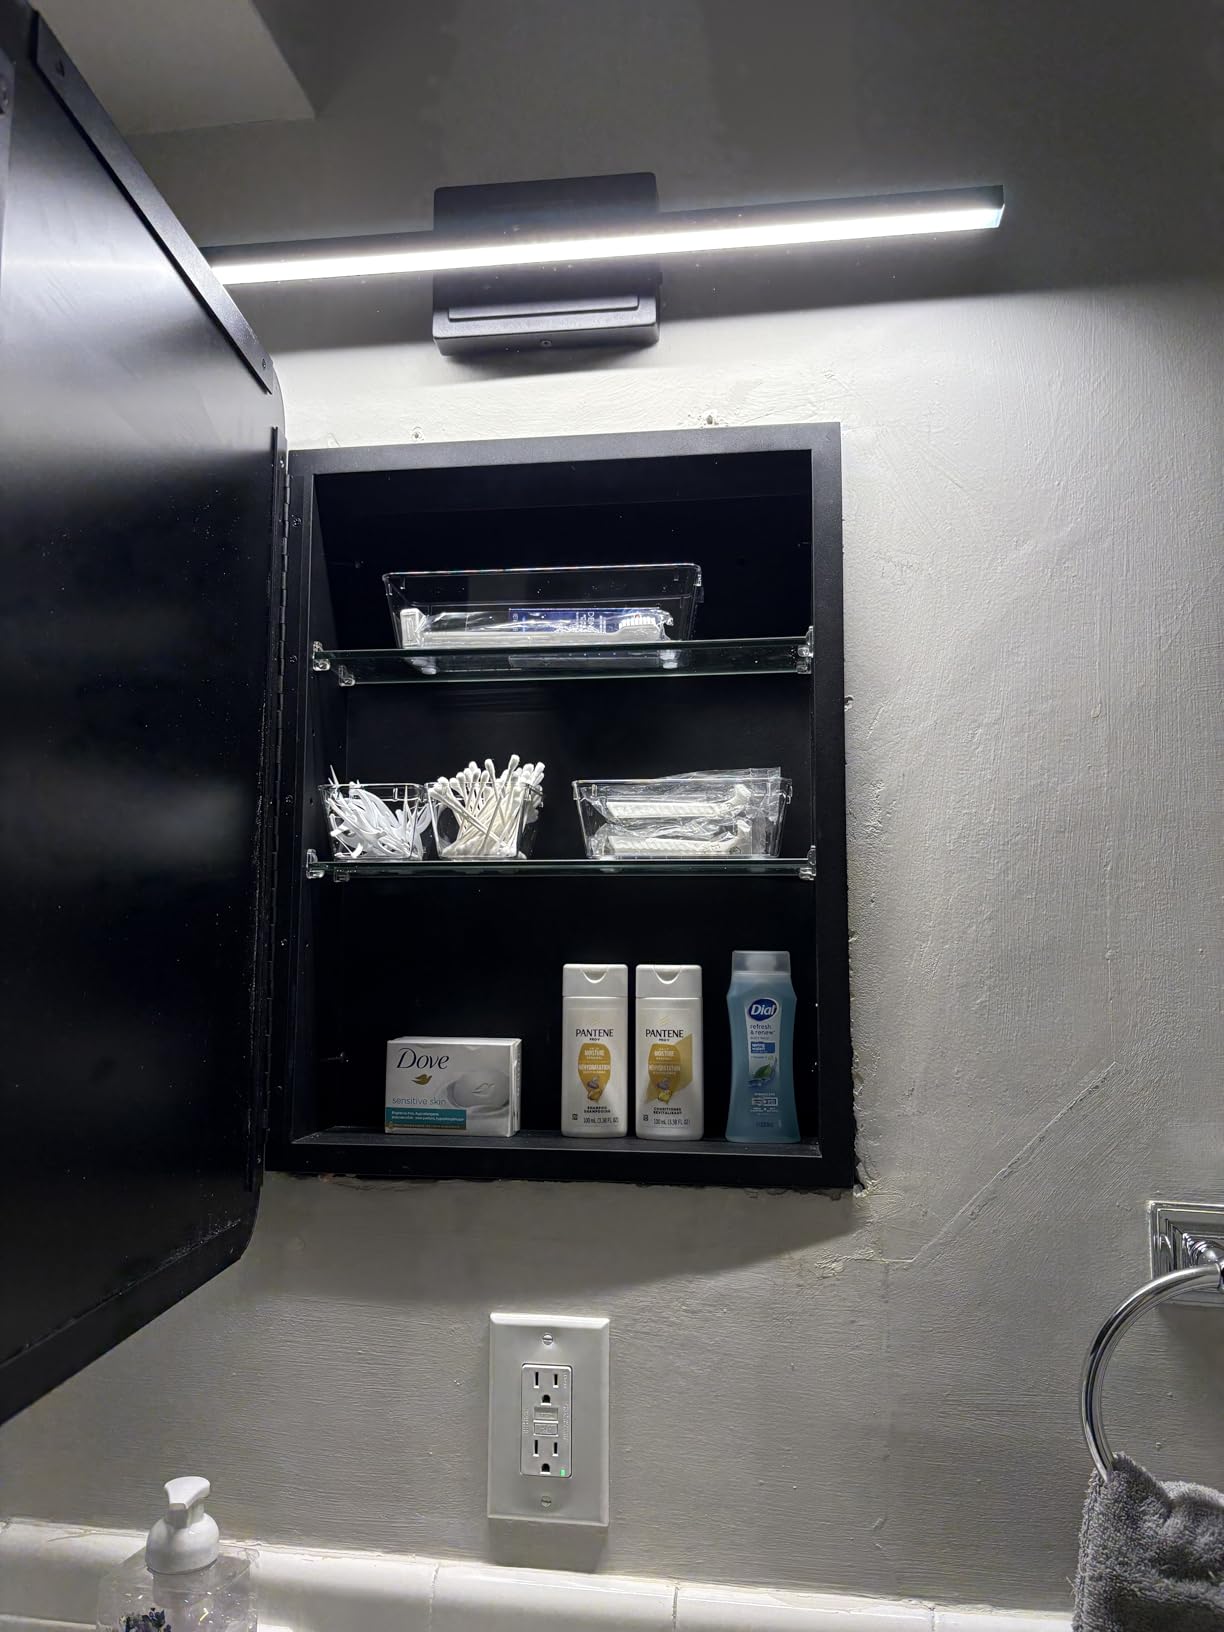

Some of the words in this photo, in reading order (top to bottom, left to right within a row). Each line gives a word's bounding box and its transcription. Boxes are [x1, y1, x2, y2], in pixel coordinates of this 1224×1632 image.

[750, 1004, 777, 1016] Dial
[575, 1028, 614, 1038] PANTENE
[645, 1028, 684, 1038] PANTENE
[396, 1047, 450, 1070] Dove
[392, 1096, 428, 1105] sensitive
[429, 1096, 447, 1105] skin
